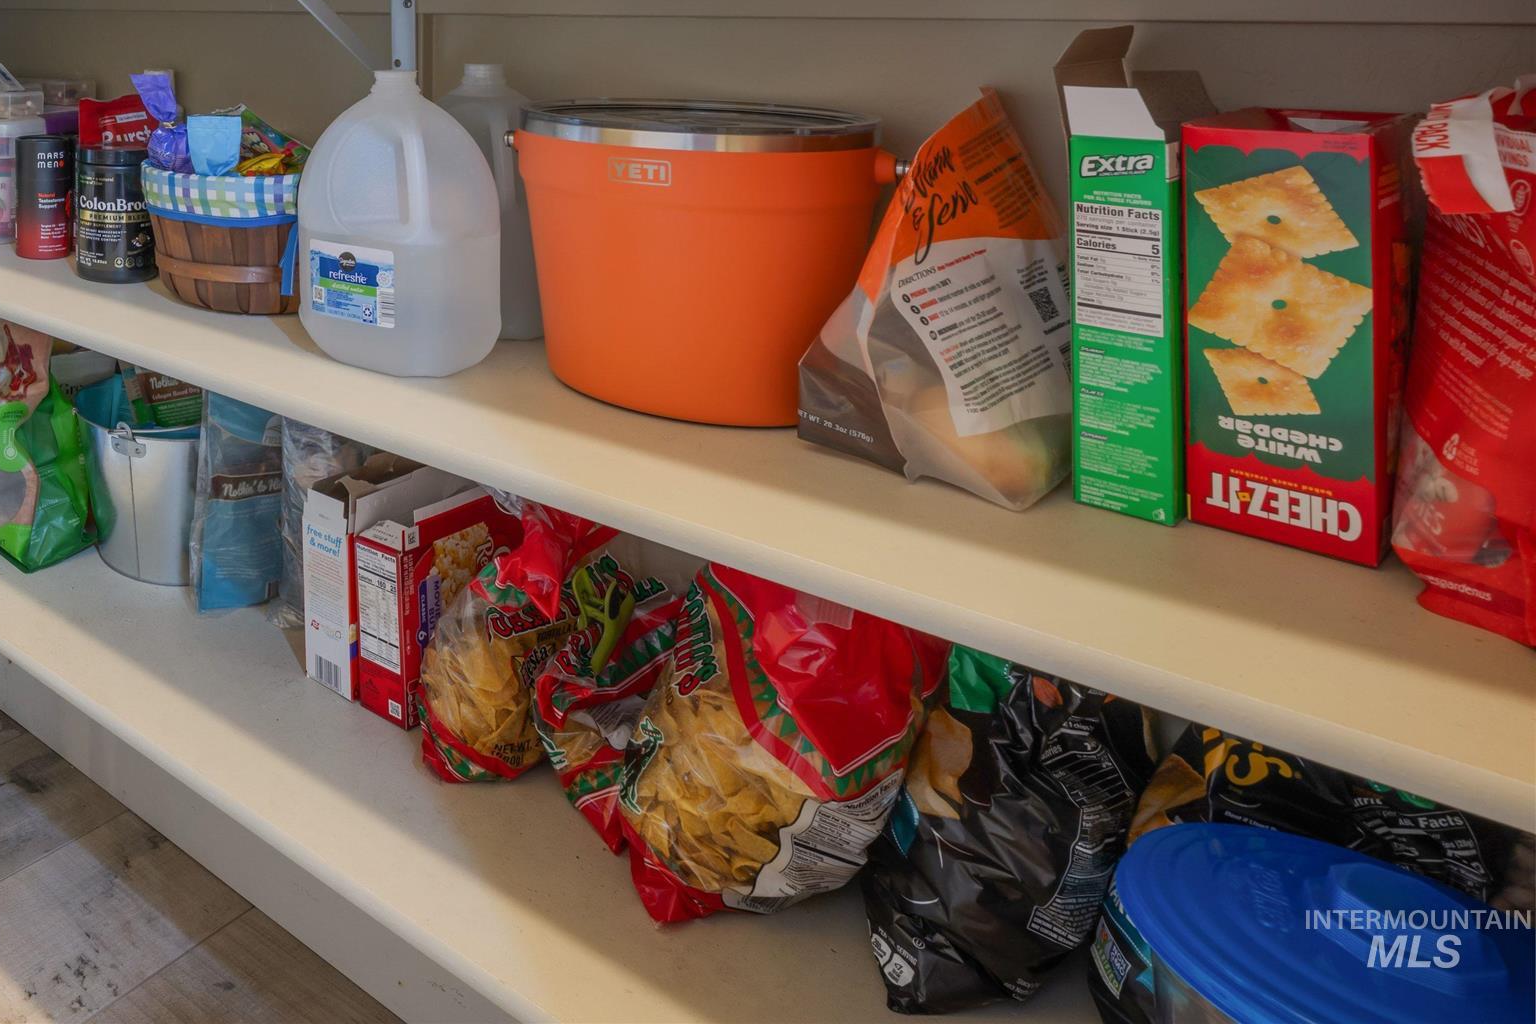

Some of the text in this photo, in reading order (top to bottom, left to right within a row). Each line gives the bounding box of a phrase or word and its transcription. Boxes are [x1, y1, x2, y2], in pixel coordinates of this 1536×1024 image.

[611, 162, 667, 182] YETI
[1080, 154, 1155, 177] Extra
[80, 195, 147, 212] ColonBroo
[90, 213, 124, 221] PREMIUM
[1076, 204, 1160, 221] Nutrition Facts
[1077, 238, 1159, 255] Calories 5
[898, 266, 936, 289] DIRECTIONS
[306, 523, 342, 548] free stuff
[309, 538, 316, 546] &
